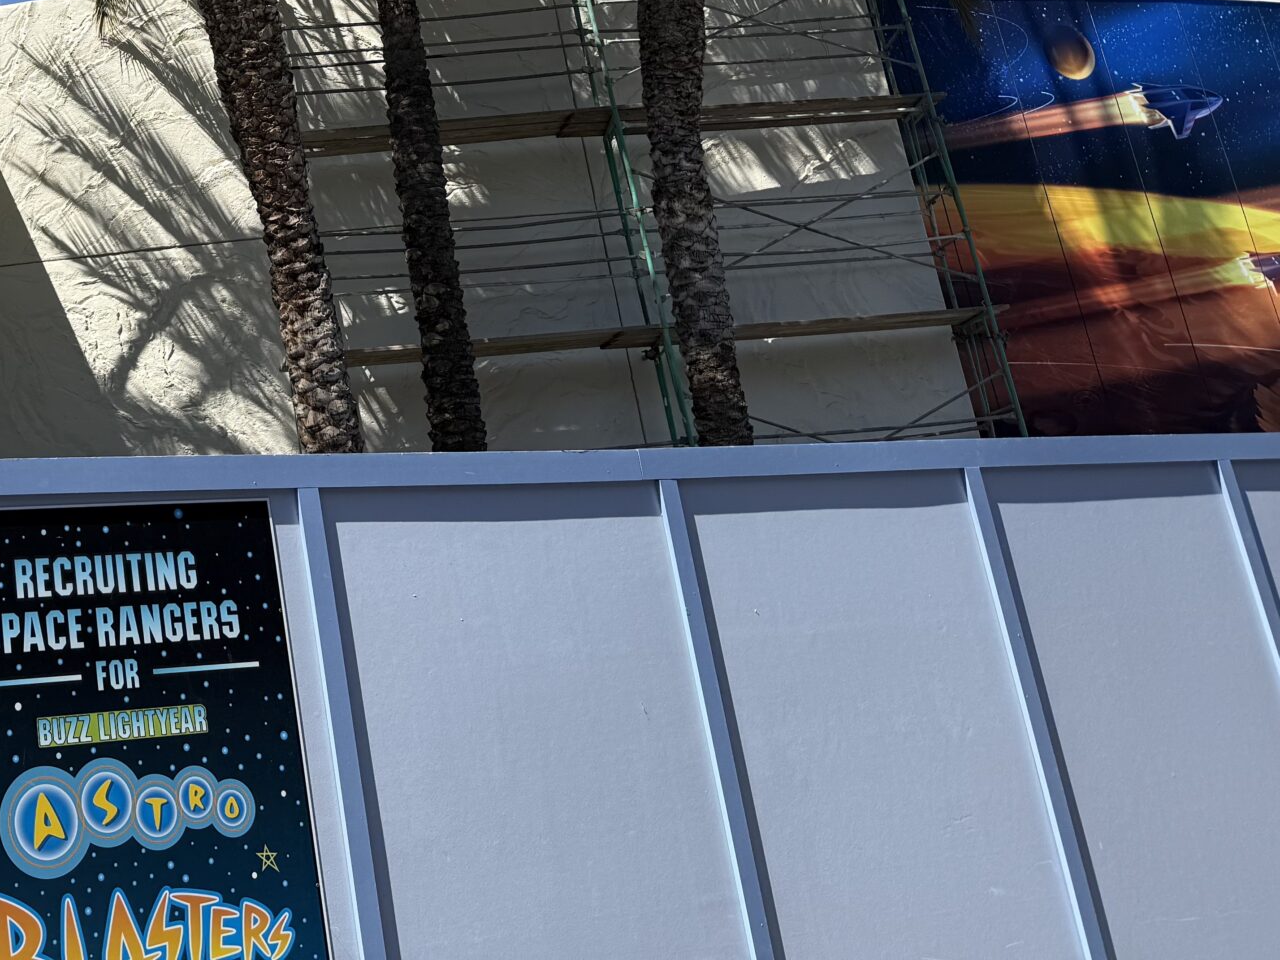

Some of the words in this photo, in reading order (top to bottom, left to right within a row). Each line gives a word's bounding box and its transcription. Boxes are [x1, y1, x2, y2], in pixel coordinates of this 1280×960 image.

[14, 550, 198, 599] RECRUITING
[96, 600, 241, 649] RANGERS
[96, 658, 141, 692] FOR
[38, 714, 93, 748] BUZZ
[97, 705, 208, 741] LIGHTYEAR
[33, 778, 242, 851] ASTRO
